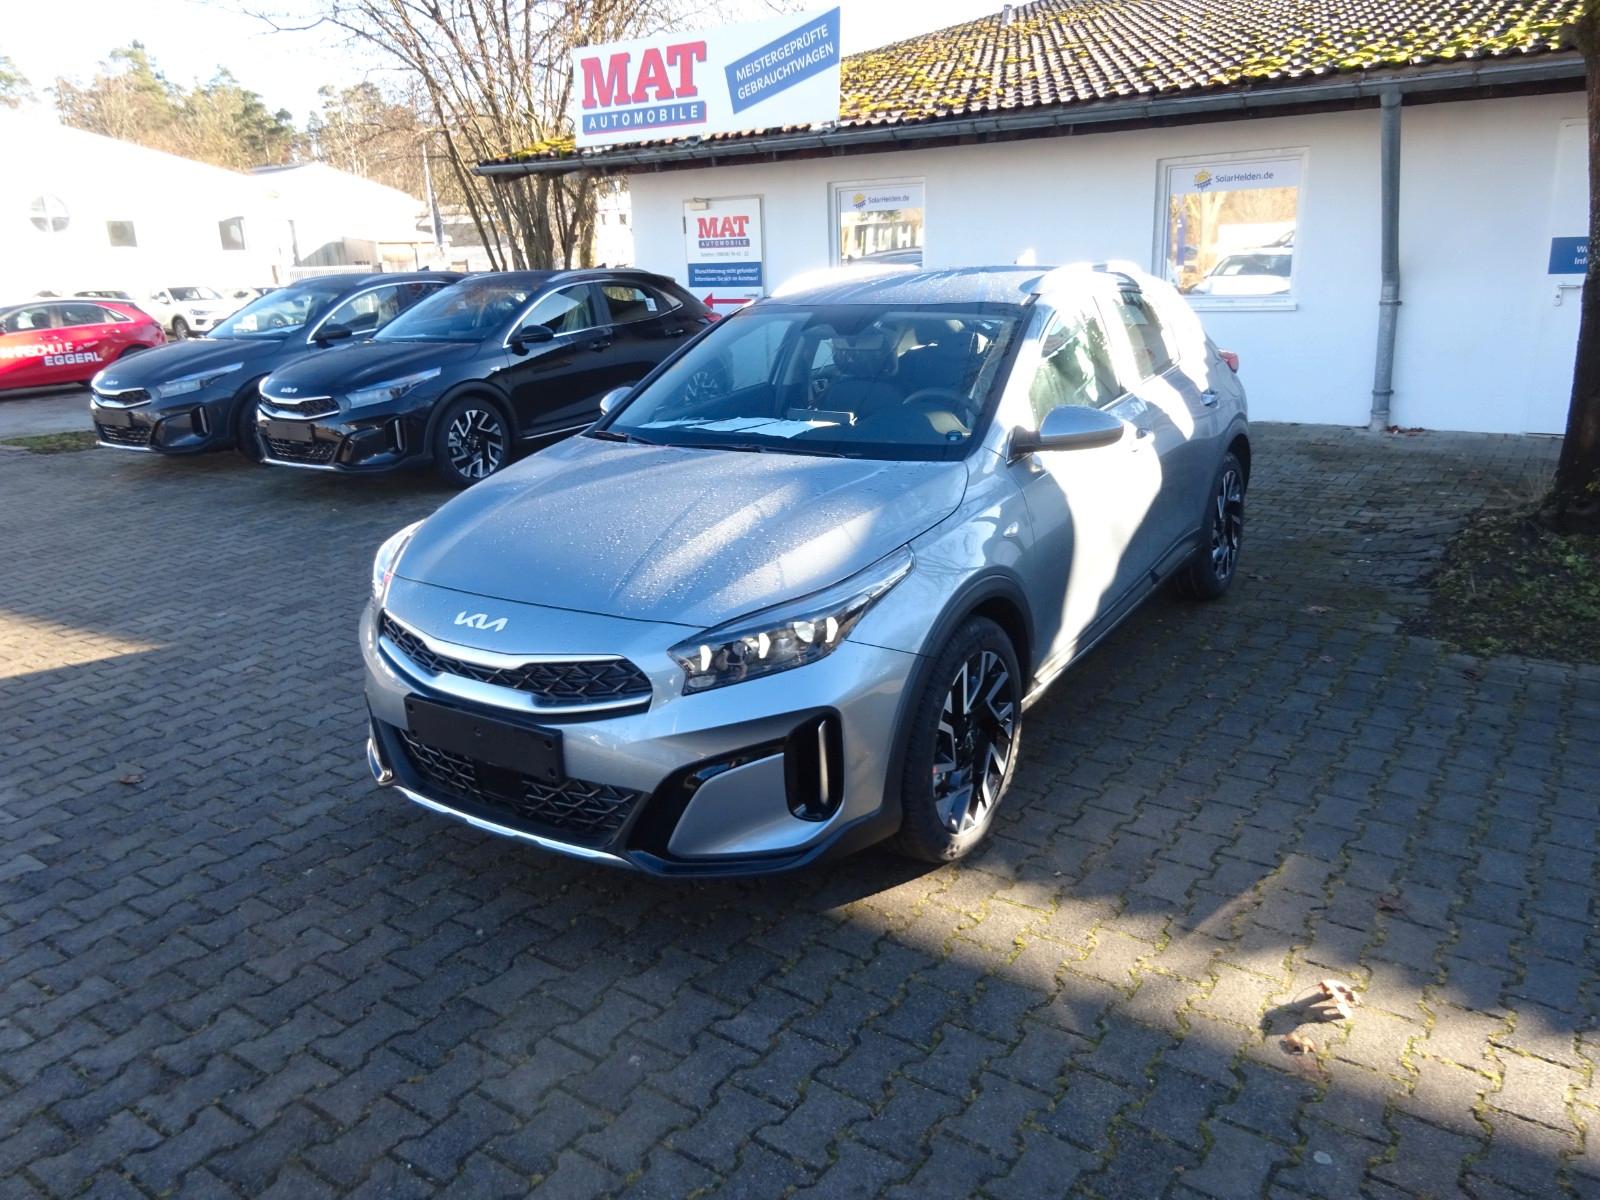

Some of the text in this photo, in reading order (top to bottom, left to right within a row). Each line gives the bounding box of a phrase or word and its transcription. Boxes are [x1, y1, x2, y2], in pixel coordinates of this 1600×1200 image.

[736, 24, 829, 82] MEISTERGEPRÜFTE
[580, 40, 707, 109] MAT
[737, 41, 834, 100] GEBRAUCHTWAGEN
[589, 105, 698, 129] AUTOMOBILE
[1215, 171, 1274, 183] SolarHelden.de
[868, 195, 910, 204] SolarHelden.de
[697, 215, 750, 239] MAT
[701, 239, 747, 248] AUTOMOBILE
[44, 352, 103, 366] EGGERL
[453, 610, 509, 632] KIA
